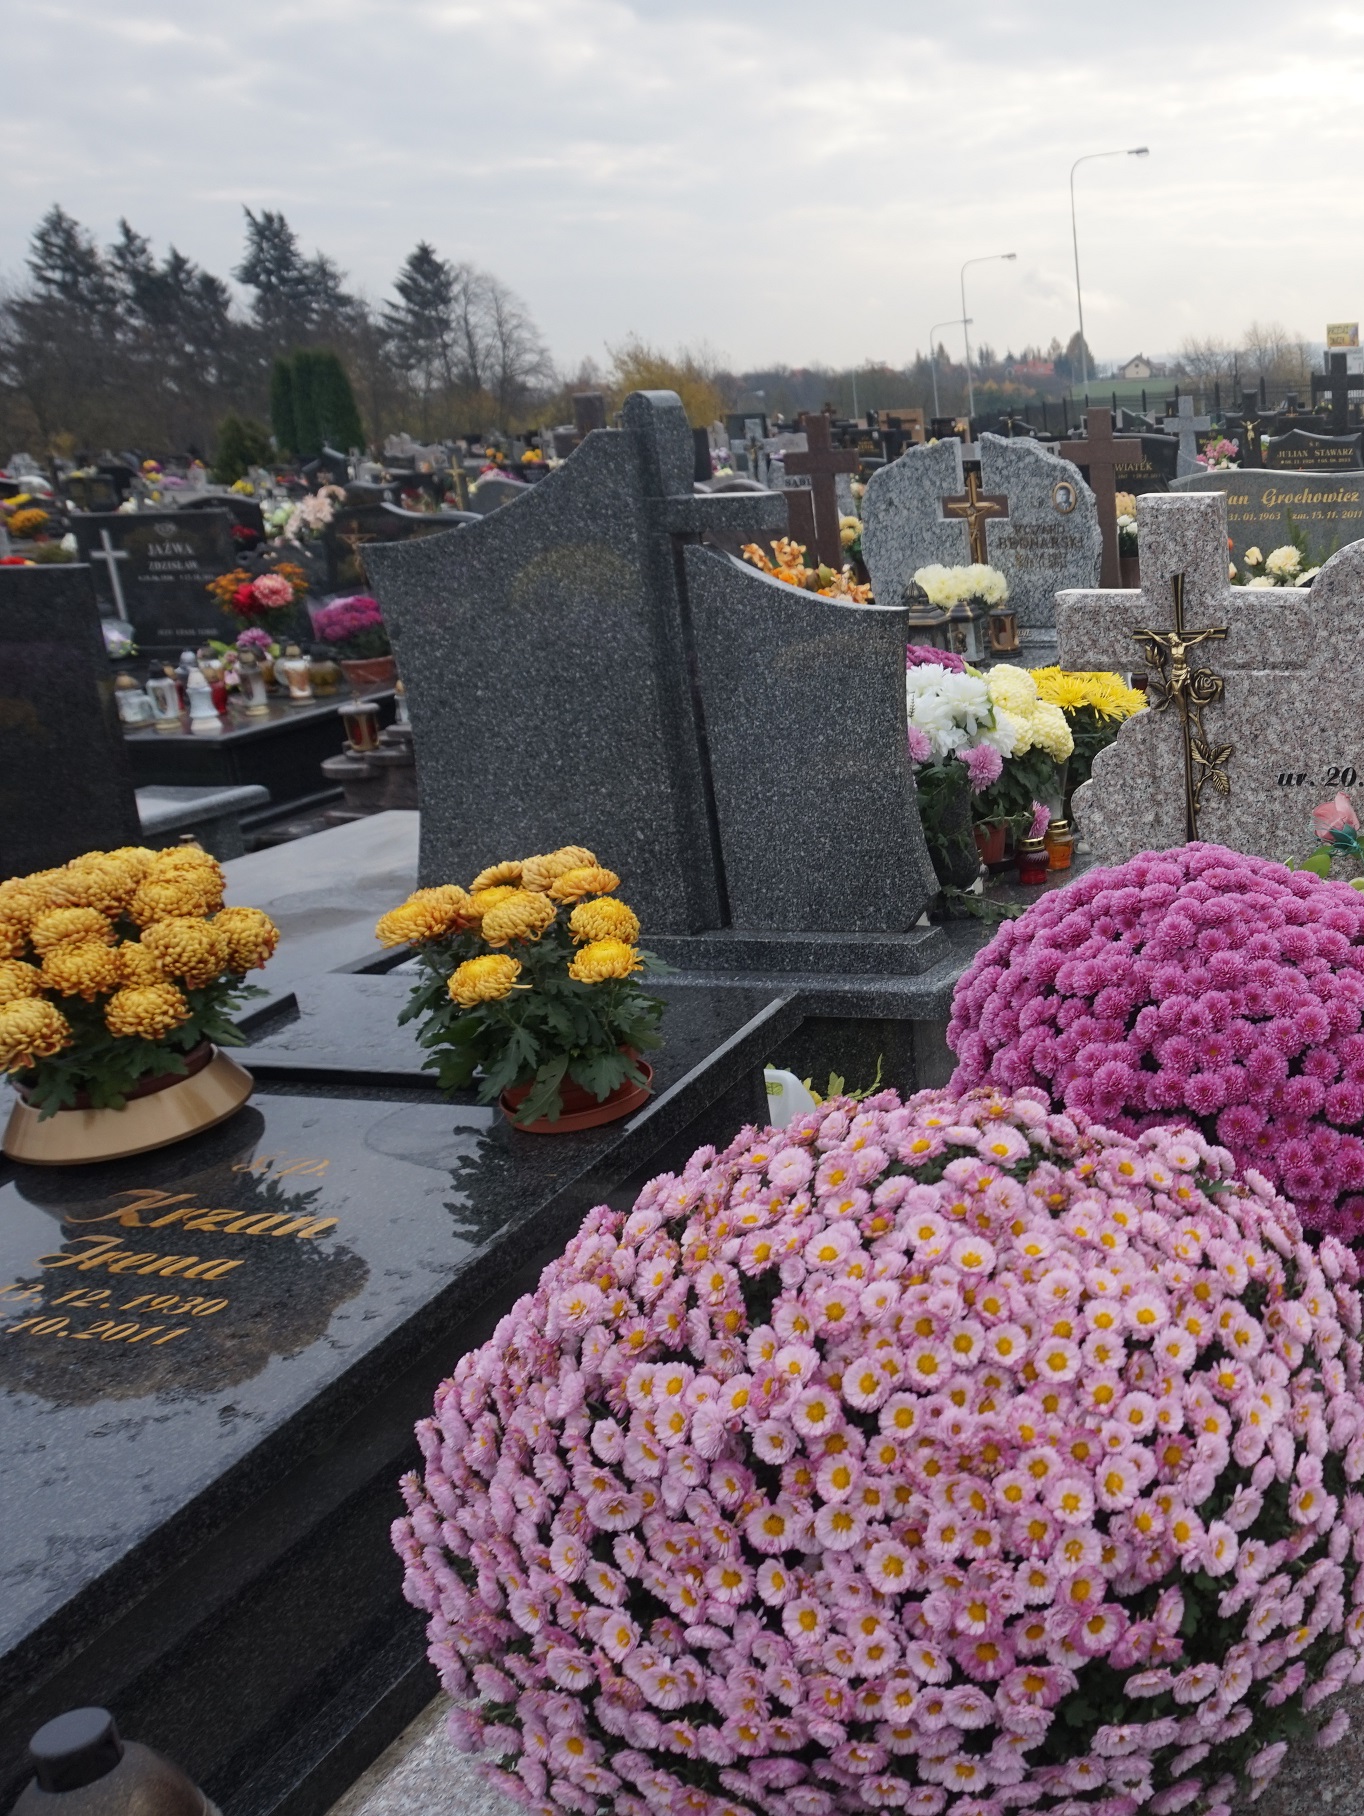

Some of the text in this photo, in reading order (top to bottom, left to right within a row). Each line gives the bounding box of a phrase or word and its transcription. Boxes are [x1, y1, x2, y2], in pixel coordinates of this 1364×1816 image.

[1277, 447, 1354, 458] JULIAN STAWARZ
[1114, 462, 1153, 471] WIATEK
[1260, 487, 1361, 508] Grochowicz
[1276, 772, 1315, 788] ur.
[1324, 766, 1364, 788] 20.
[64, 1188, 341, 1240] Krzan
[32, 1234, 246, 1281] Irena
